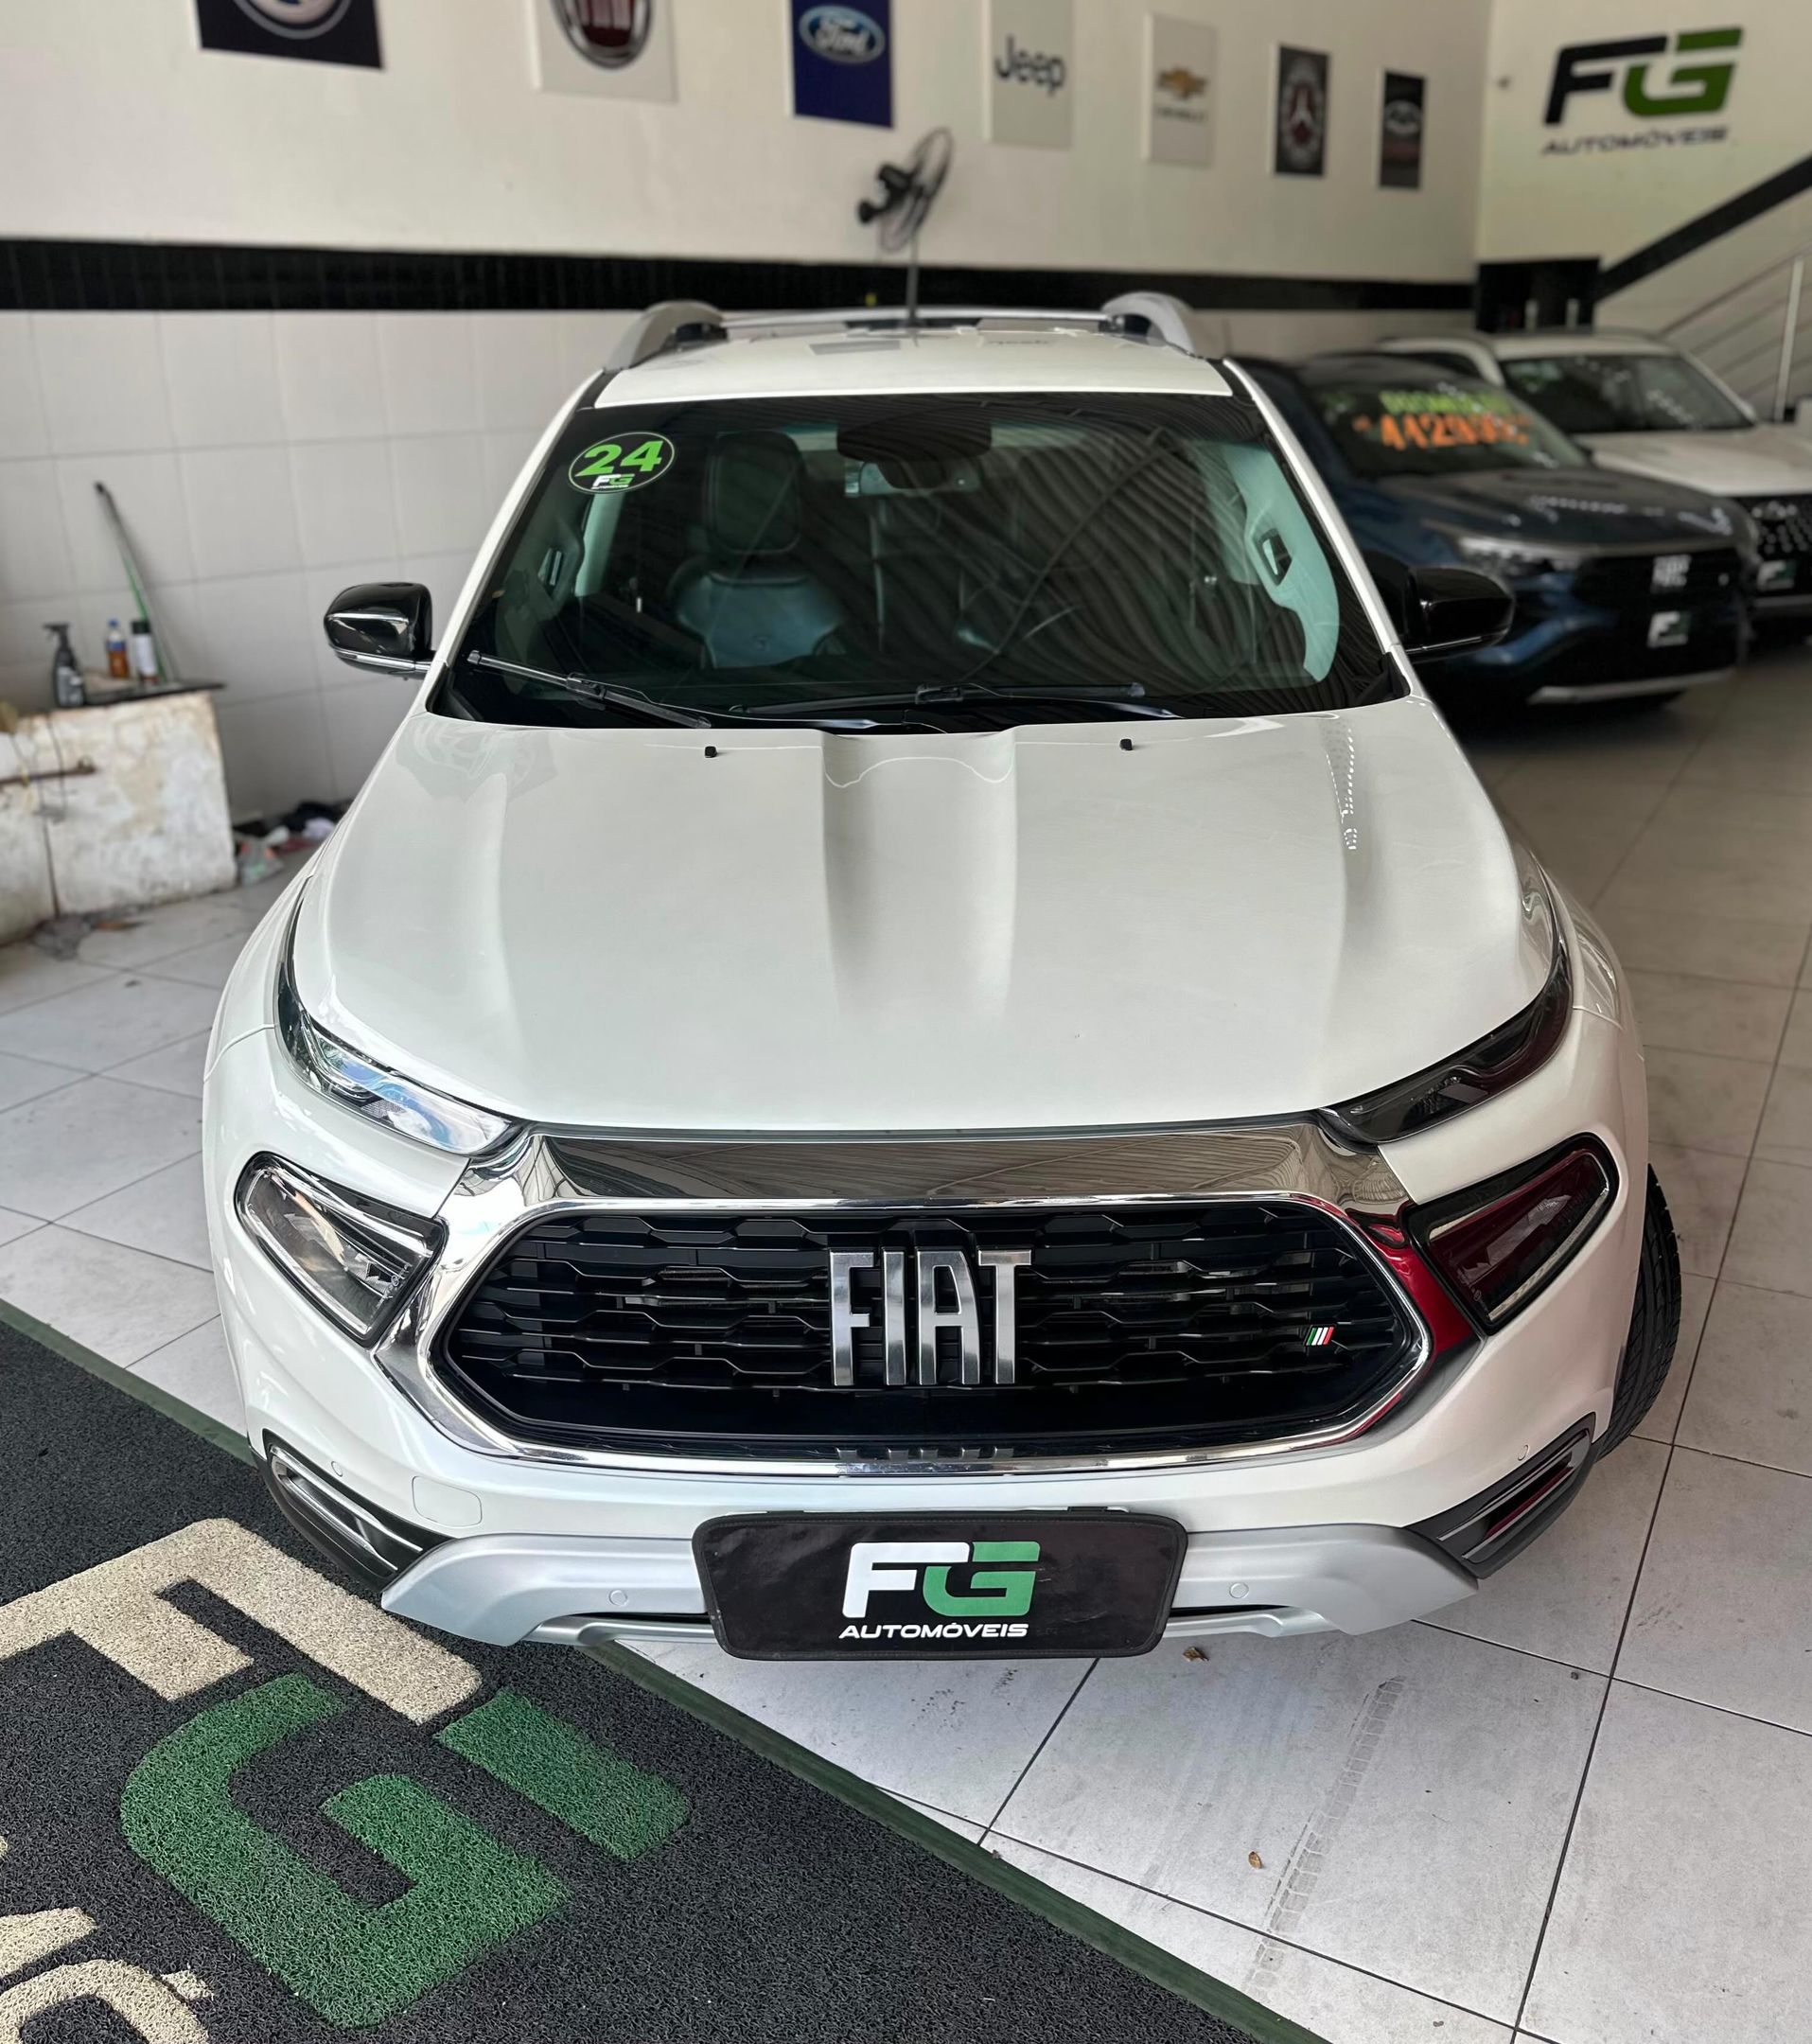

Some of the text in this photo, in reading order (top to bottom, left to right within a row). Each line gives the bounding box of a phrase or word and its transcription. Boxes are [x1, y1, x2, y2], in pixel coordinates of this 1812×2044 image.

[995, 34, 1066, 97] Jeep
[1543, 26, 1743, 126] FG
[574, 440, 663, 477] 24
[591, 473, 635, 487] FG
[829, 1247, 1032, 1386] FIAT
[841, 1540, 1041, 1618] FG
[838, 1621, 1029, 1639] AUTOMÓVEIS
